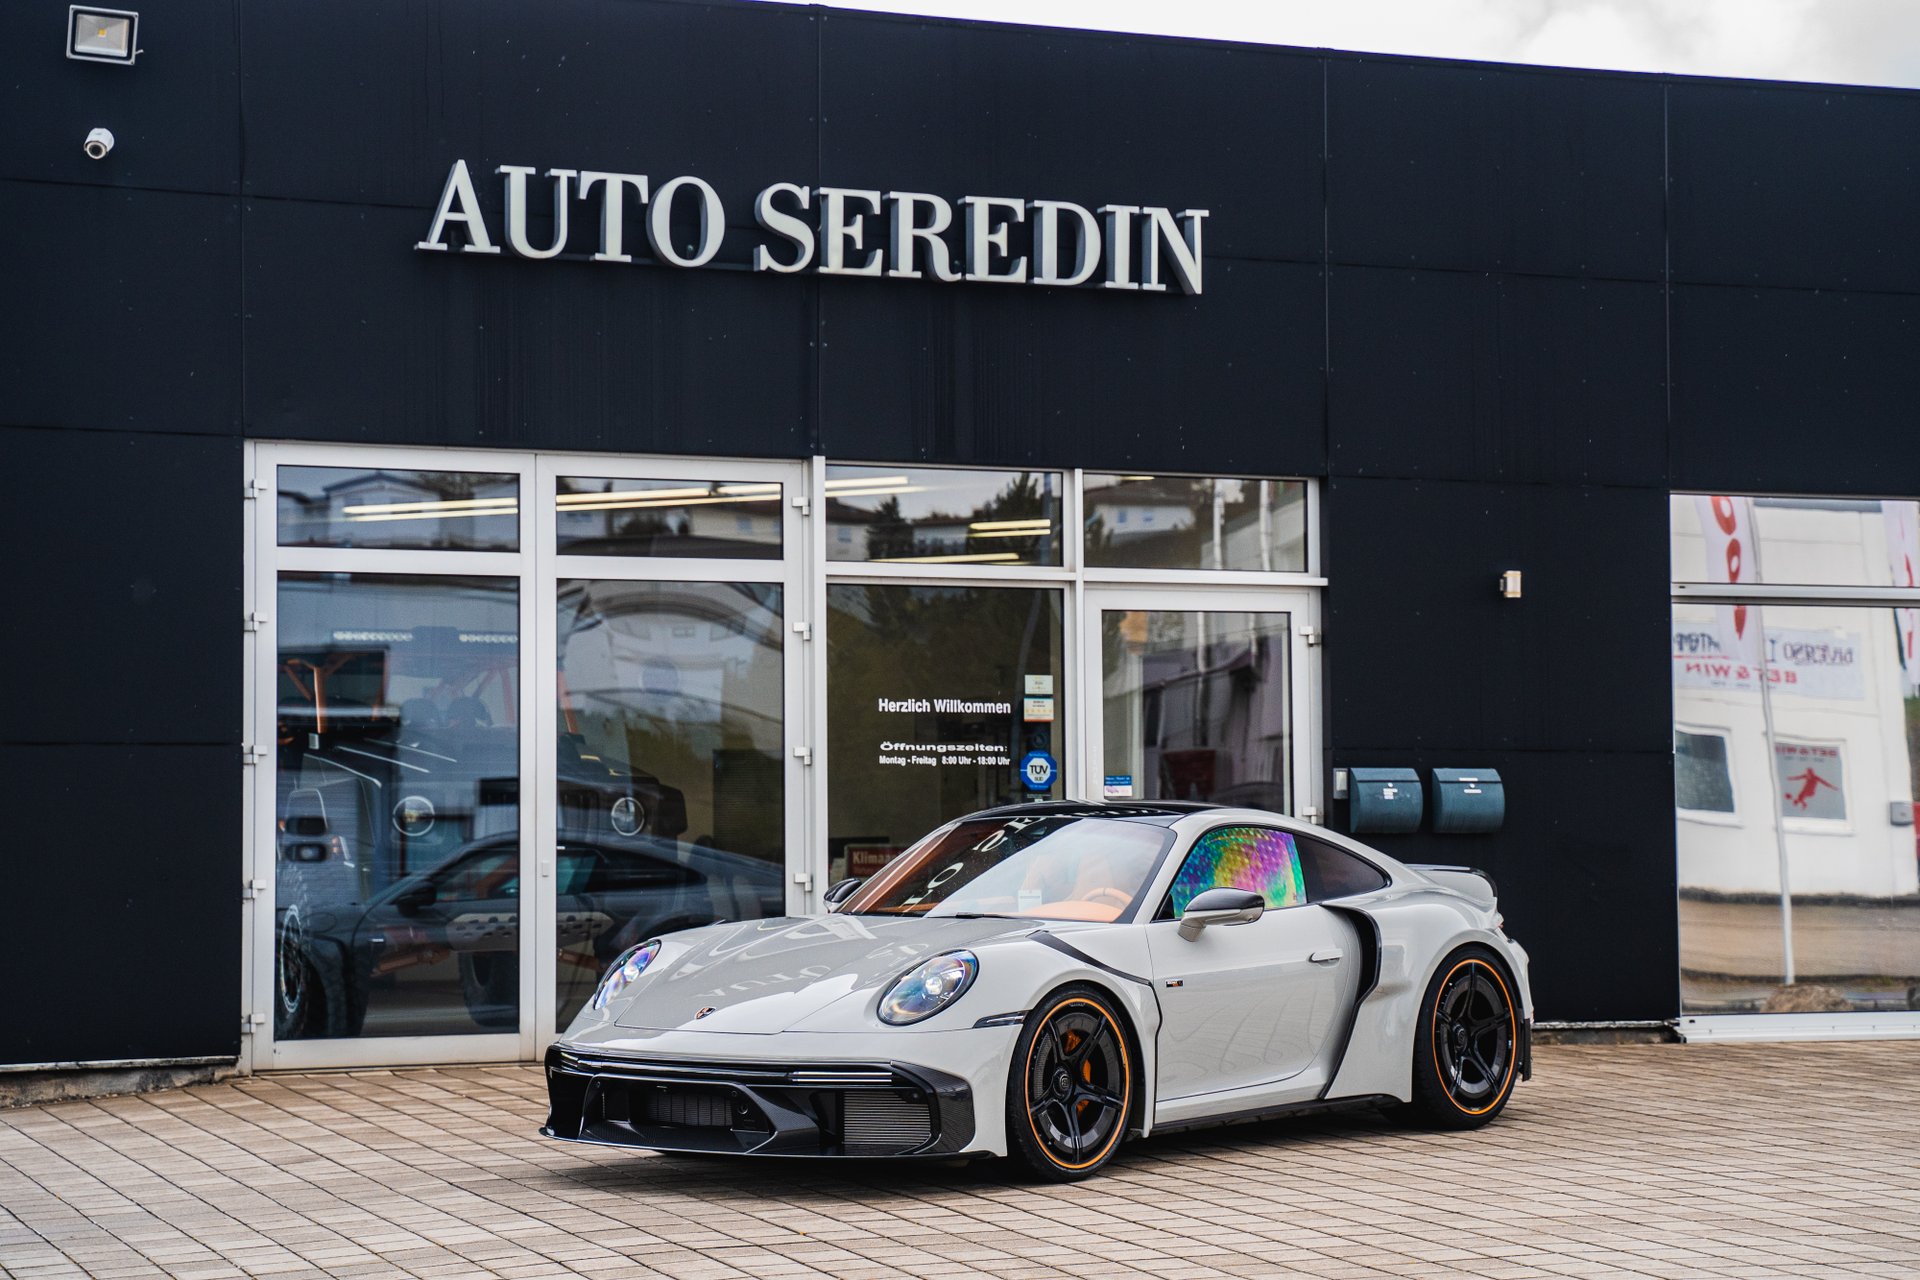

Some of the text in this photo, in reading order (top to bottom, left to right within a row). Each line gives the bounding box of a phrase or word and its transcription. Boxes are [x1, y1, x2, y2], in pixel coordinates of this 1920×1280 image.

[415, 158, 1210, 296] AUTO SEREDIN
[878, 698, 931, 713] Herzlich
[934, 698, 1011, 715] Willkommen
[879, 740, 1008, 753] Öffnungszeiten:
[879, 755, 906, 767] Montag
[912, 755, 937, 767] Freitag
[941, 756, 957, 766] 8:00
[957, 756, 972, 766] Uhr
[977, 756, 995, 766] 18:00
[995, 756, 1011, 766] Uhr
[1029, 764, 1049, 775] TÜV
